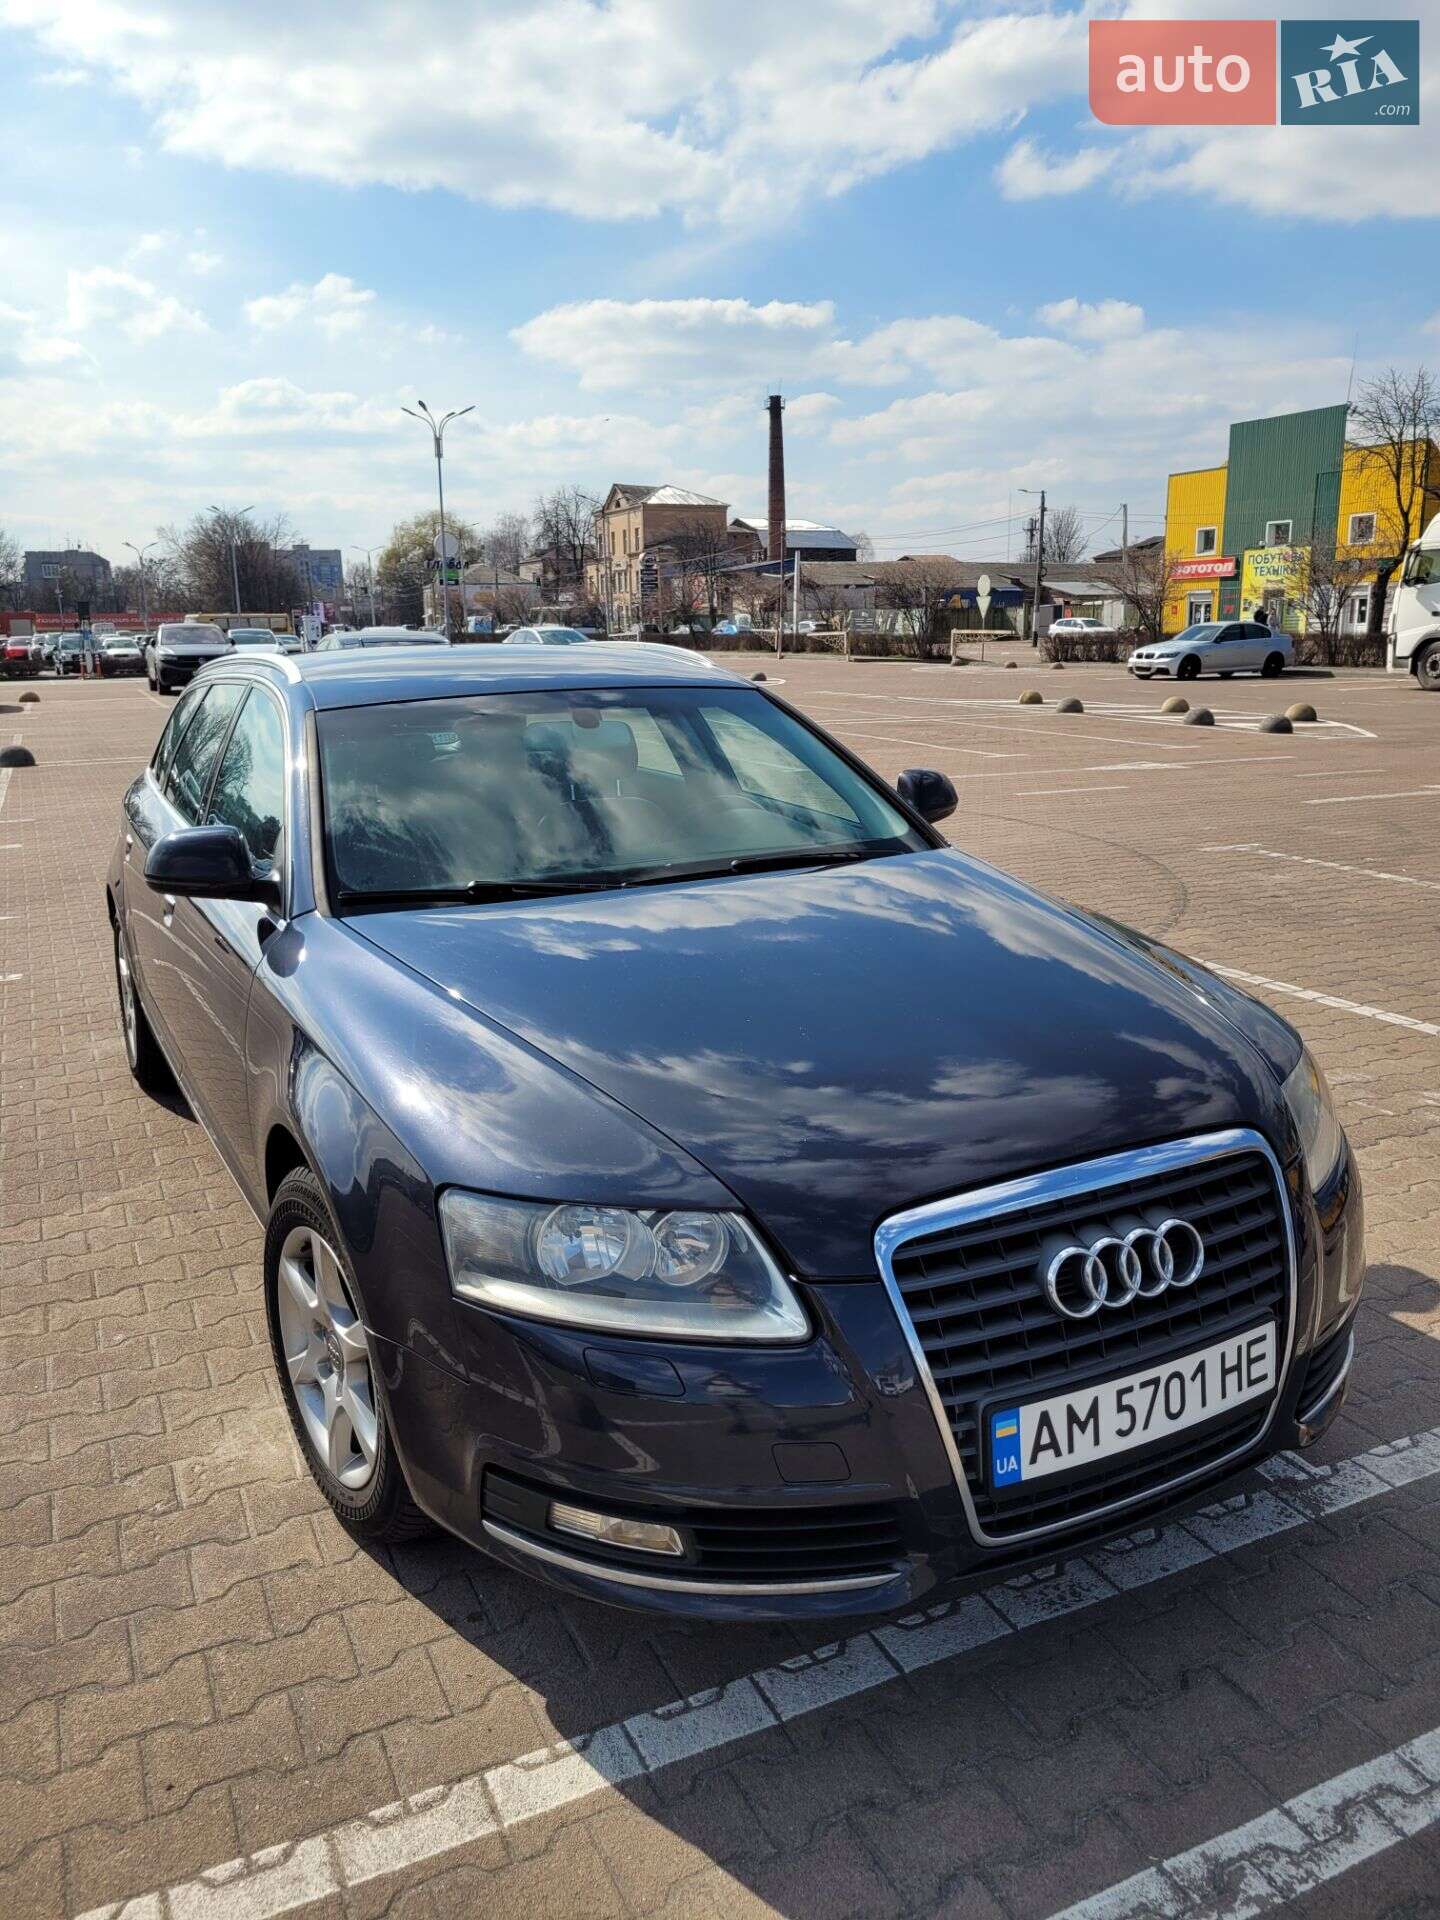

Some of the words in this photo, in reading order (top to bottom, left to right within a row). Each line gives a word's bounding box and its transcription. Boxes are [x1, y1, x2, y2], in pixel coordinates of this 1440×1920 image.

[1248, 551, 1304, 565] ПОБУТВ
[1029, 1396, 1100, 1465] AM
[1115, 1360, 1207, 1438] 5701
[1221, 1334, 1268, 1400] HE
[996, 1456, 1018, 1475] UA
